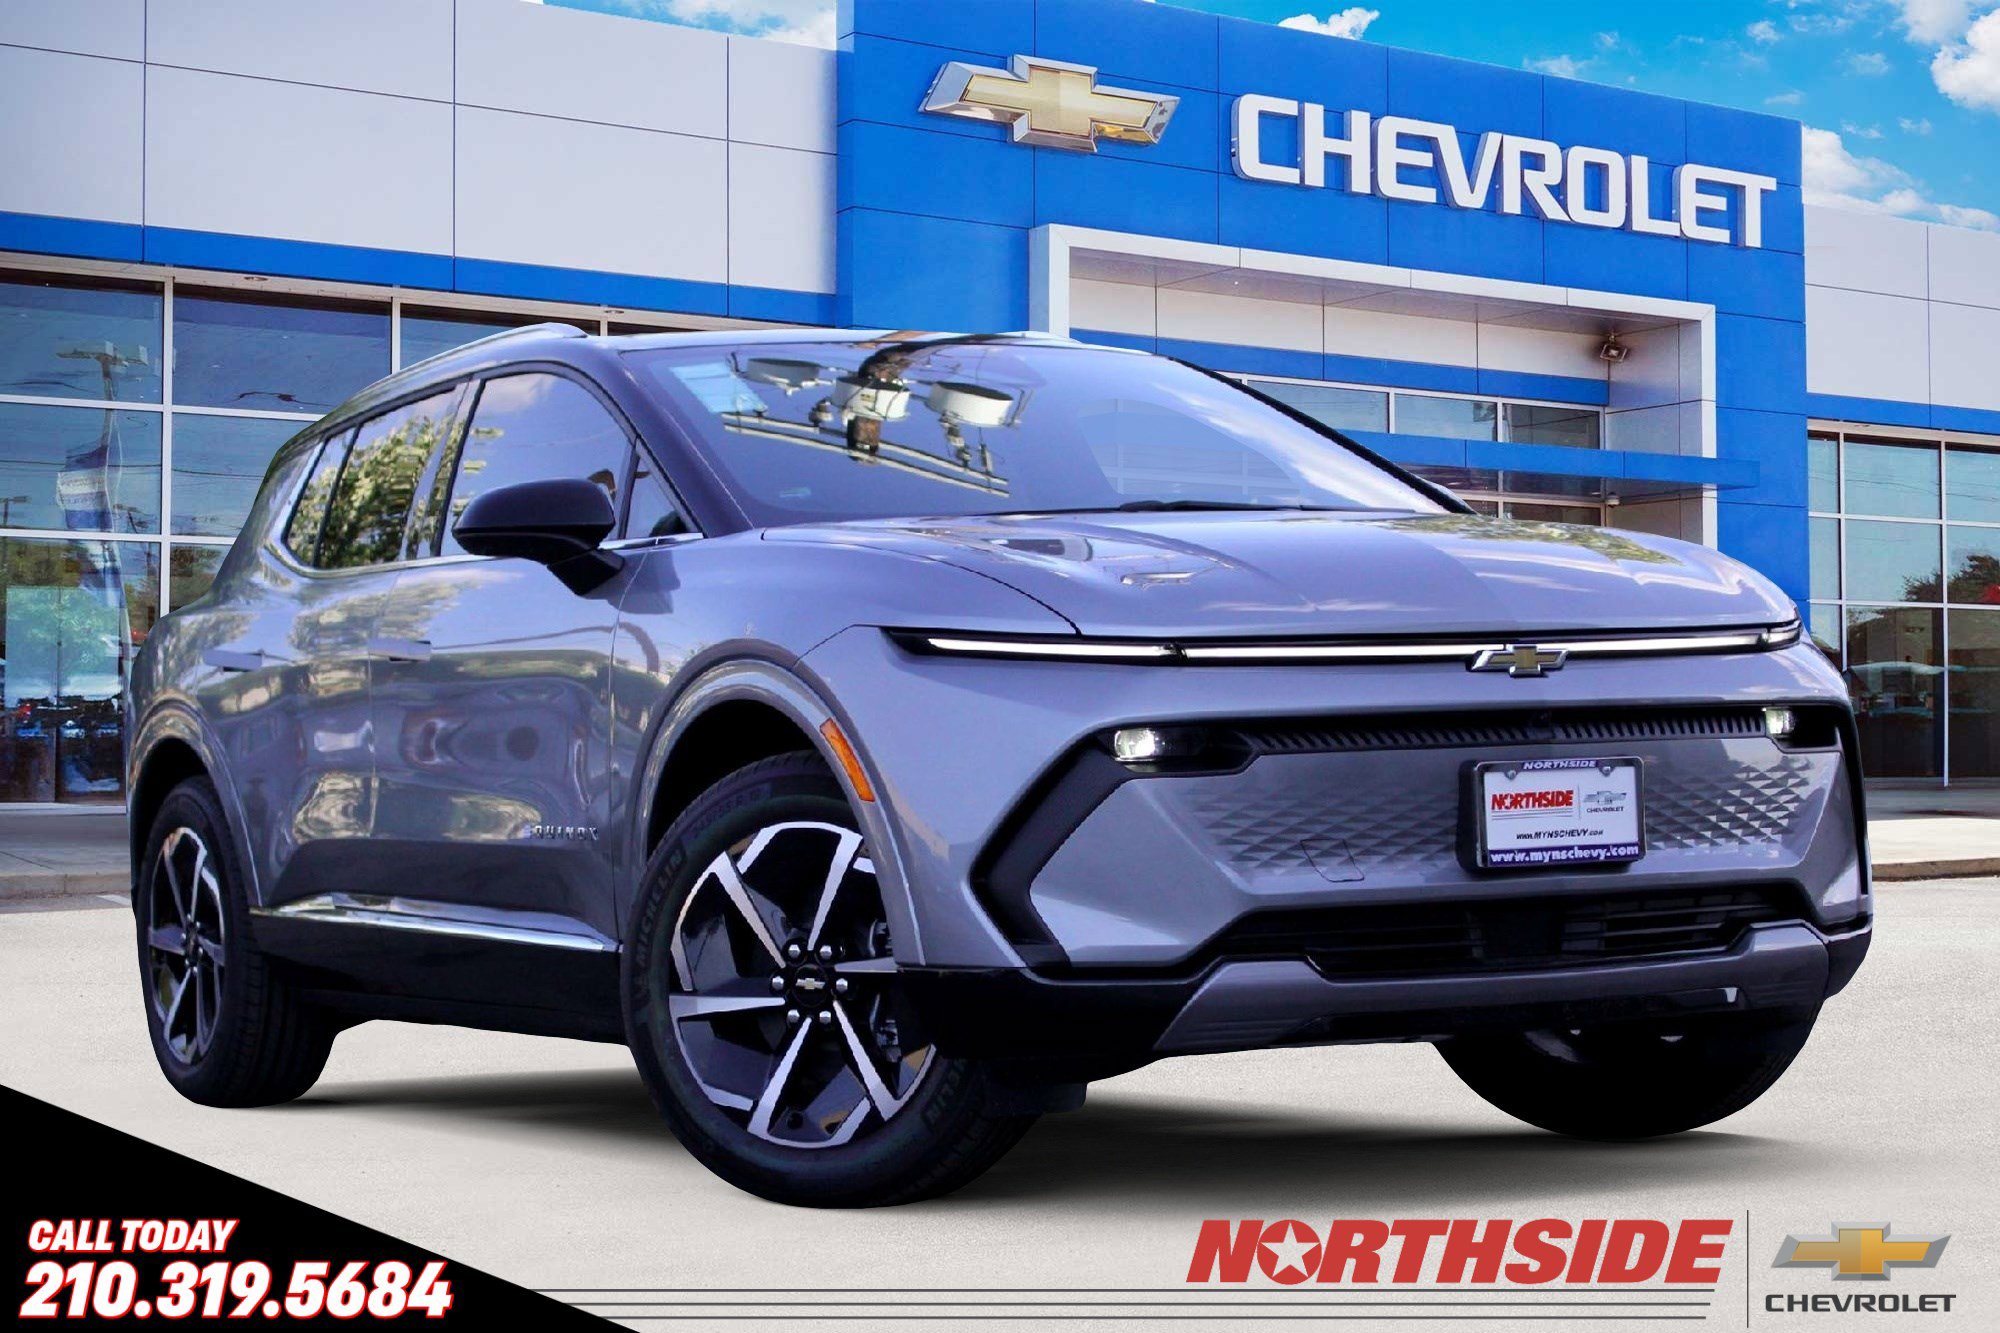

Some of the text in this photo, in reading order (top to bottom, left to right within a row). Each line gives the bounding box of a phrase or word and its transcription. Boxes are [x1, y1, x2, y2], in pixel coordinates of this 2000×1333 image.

[1231, 93, 1777, 248] CHEVROLET
[1523, 760, 1597, 770] NORTHSIDE
[1491, 790, 1574, 810] NORTHSIDE
[1490, 845, 1639, 864] www.mynschevy.com
